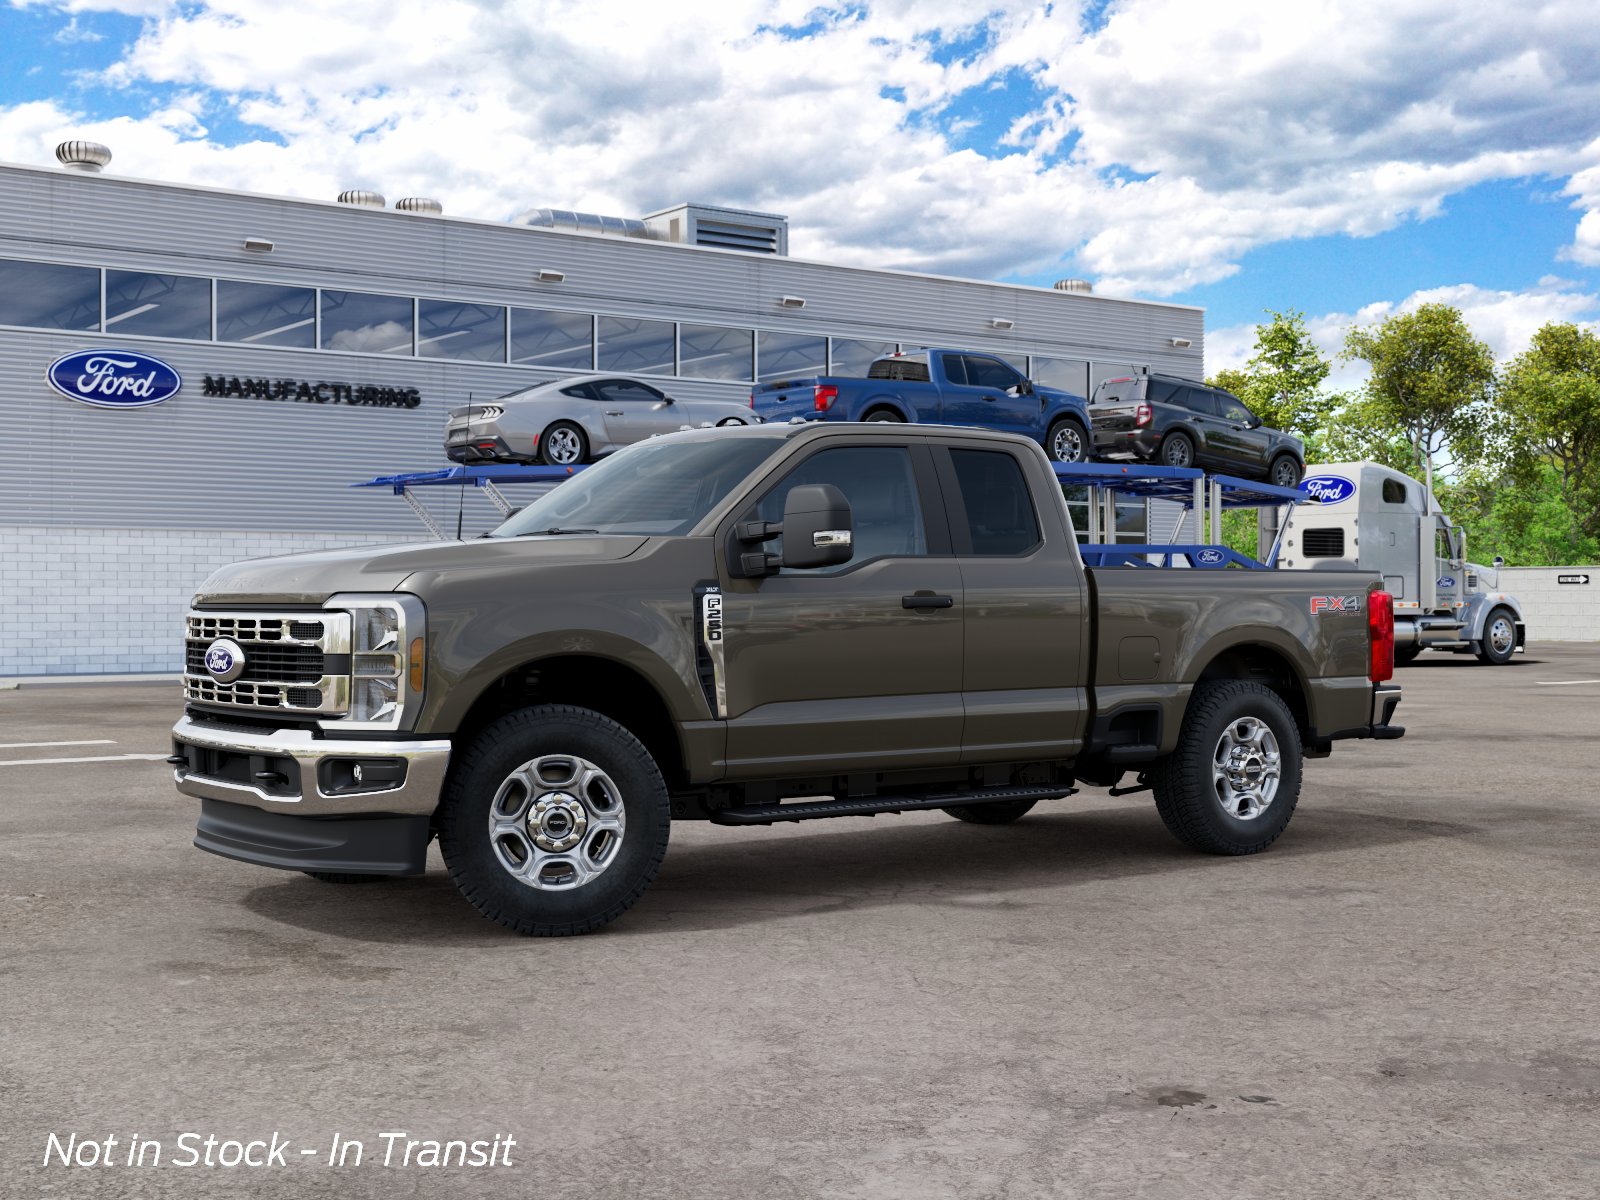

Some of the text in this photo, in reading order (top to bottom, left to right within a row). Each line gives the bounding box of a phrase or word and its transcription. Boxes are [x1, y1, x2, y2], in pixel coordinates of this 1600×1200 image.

[77, 356, 157, 398] Ford
[203, 375, 422, 409] MANUFACTURING
[1305, 479, 1343, 500] Ford
[1201, 550, 1220, 562] Ford
[1310, 596, 1361, 616] FX4
[209, 650, 229, 670] Ford
